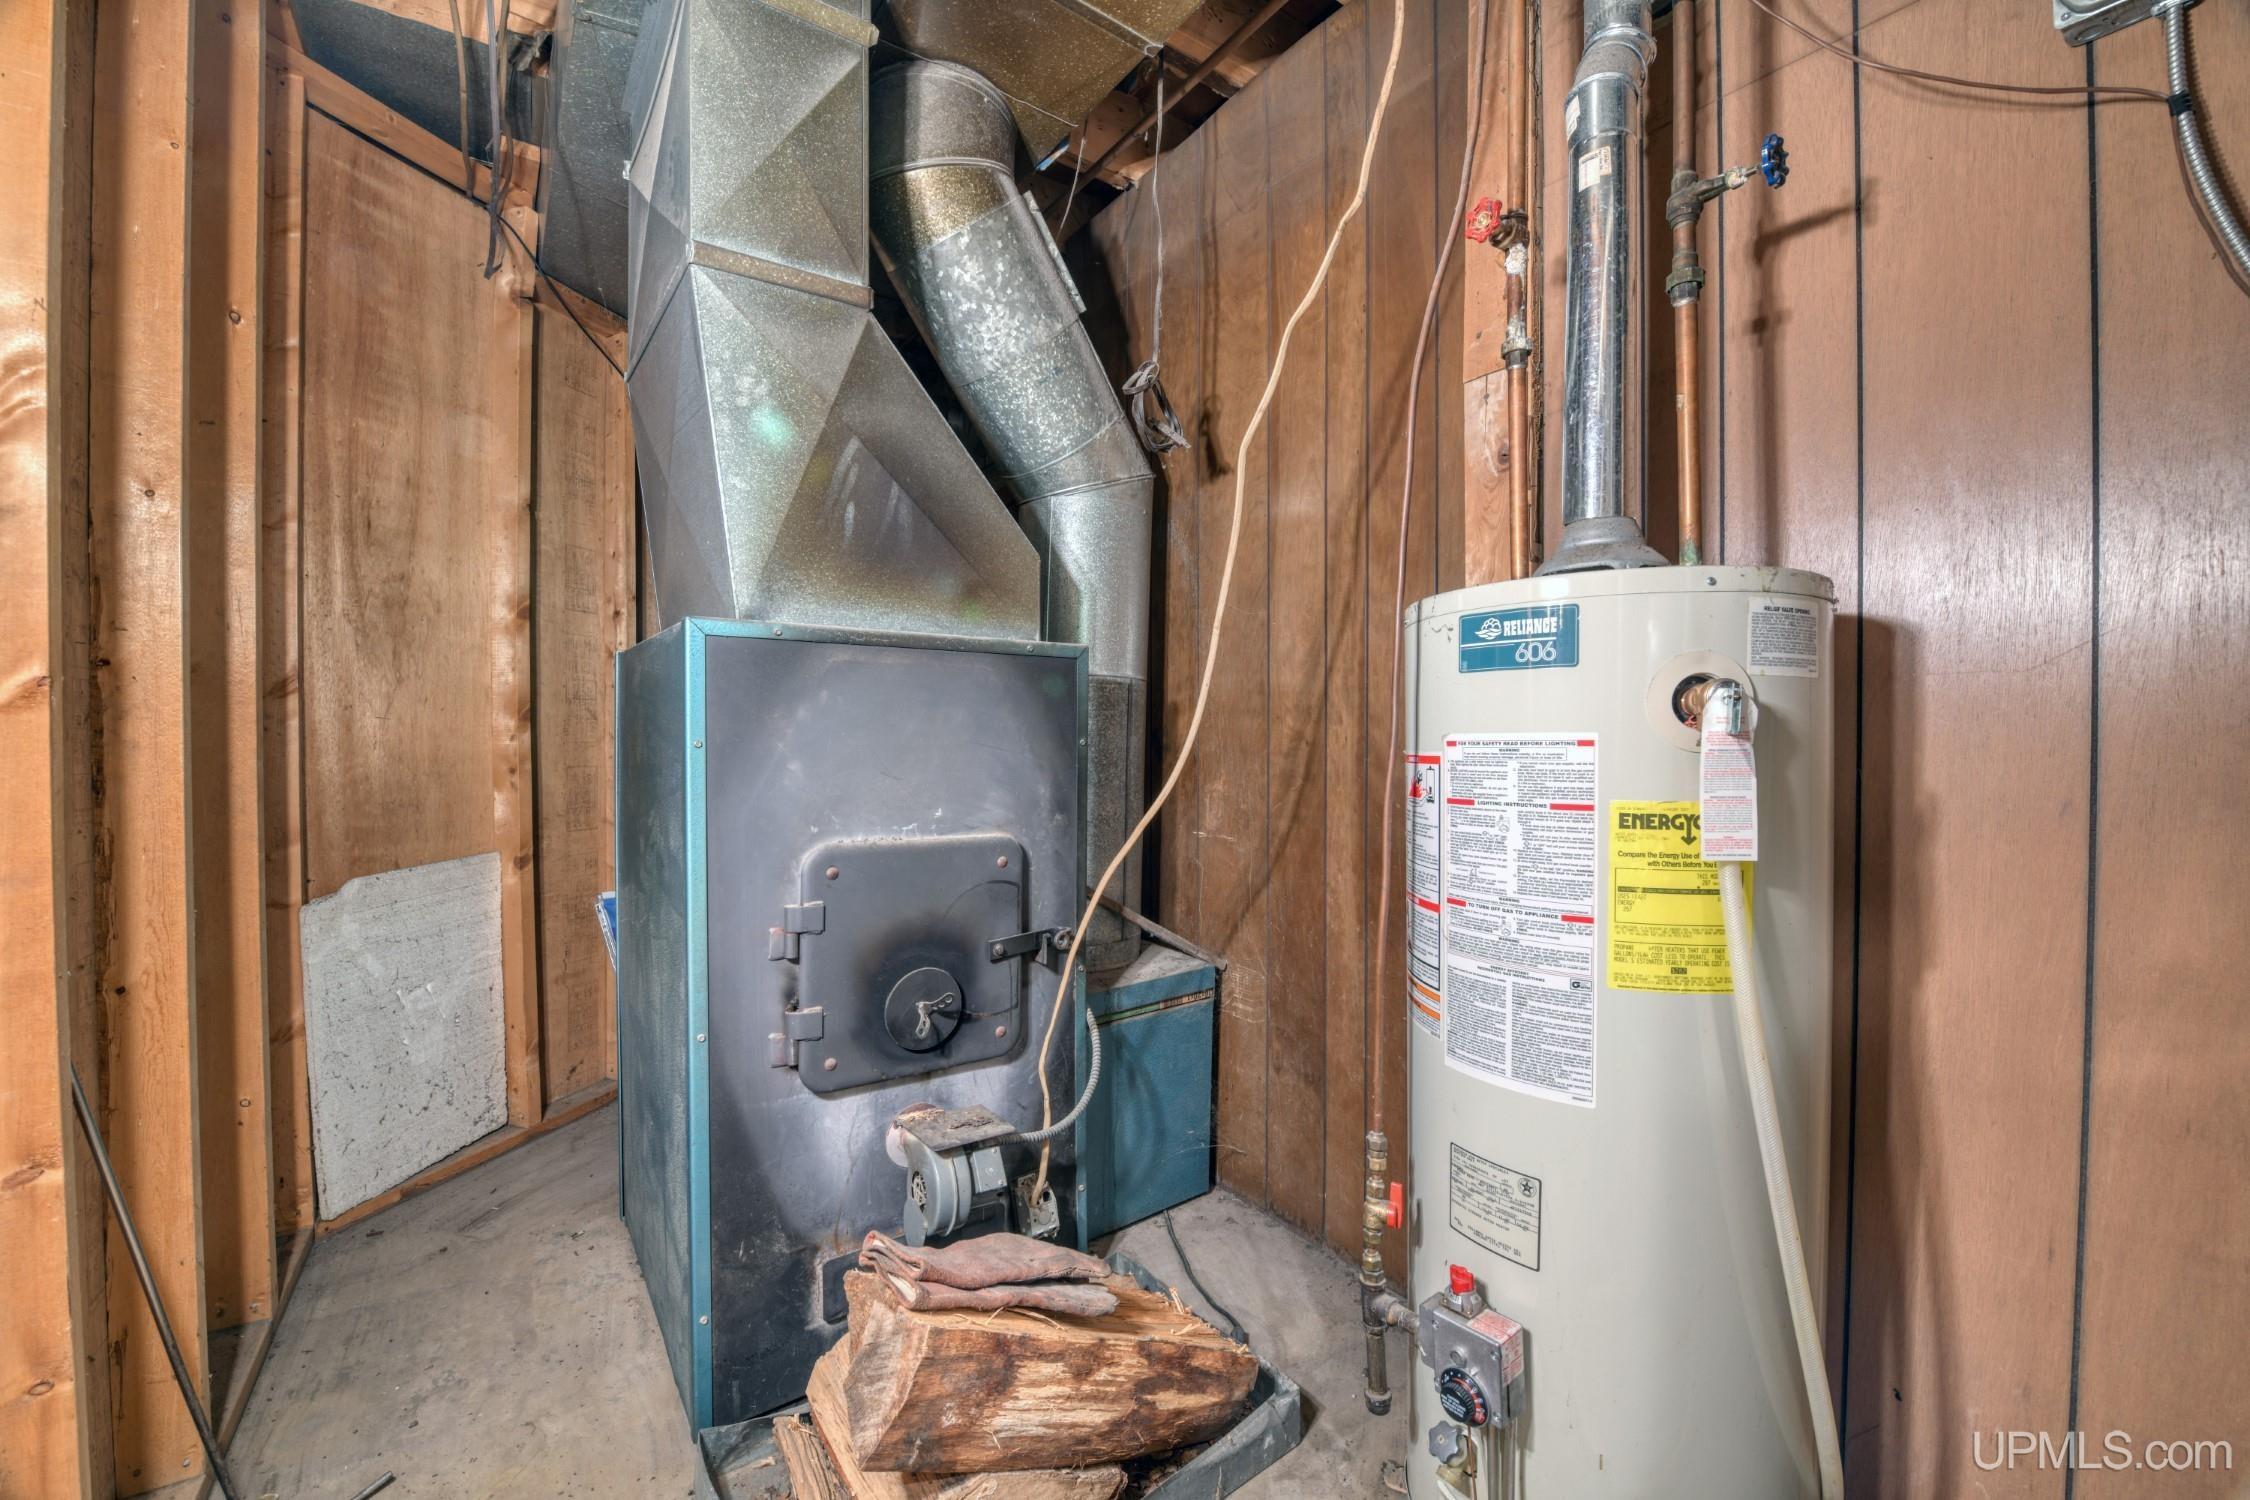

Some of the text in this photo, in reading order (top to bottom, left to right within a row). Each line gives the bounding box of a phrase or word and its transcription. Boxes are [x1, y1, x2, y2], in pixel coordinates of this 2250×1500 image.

[1503, 616, 1558, 637] RELIANCE
[1515, 640, 1557, 663] 606
[1503, 801, 1548, 809] INSTRUCTIONS
[1617, 850, 1700, 860] Compare the Energy Use of
[1476, 903, 1490, 911] TURN
[1524, 911, 1559, 920] APPLIANCE
